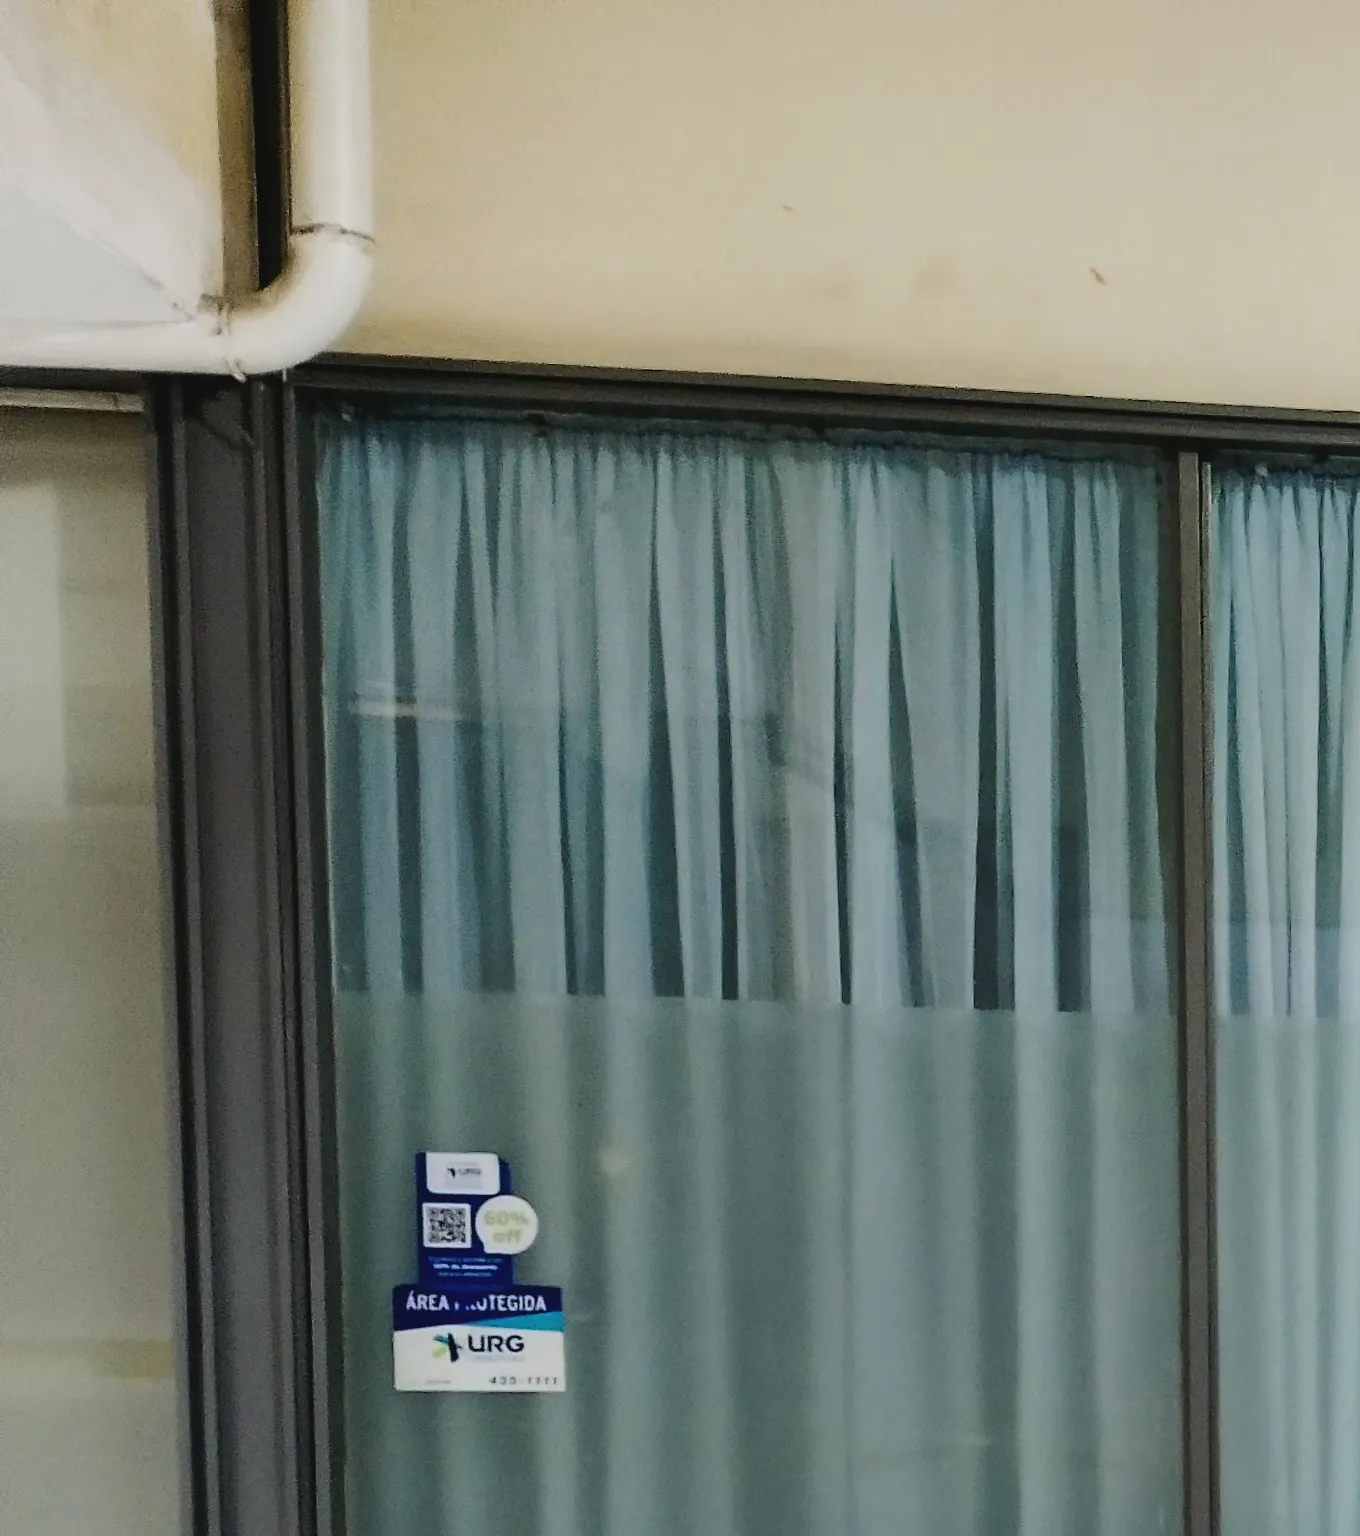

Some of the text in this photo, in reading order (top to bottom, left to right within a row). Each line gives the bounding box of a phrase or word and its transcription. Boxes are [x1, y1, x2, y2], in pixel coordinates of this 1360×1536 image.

[405, 1289, 547, 1312] ÁREA OTEGIDA
[467, 1334, 525, 1353] URG
